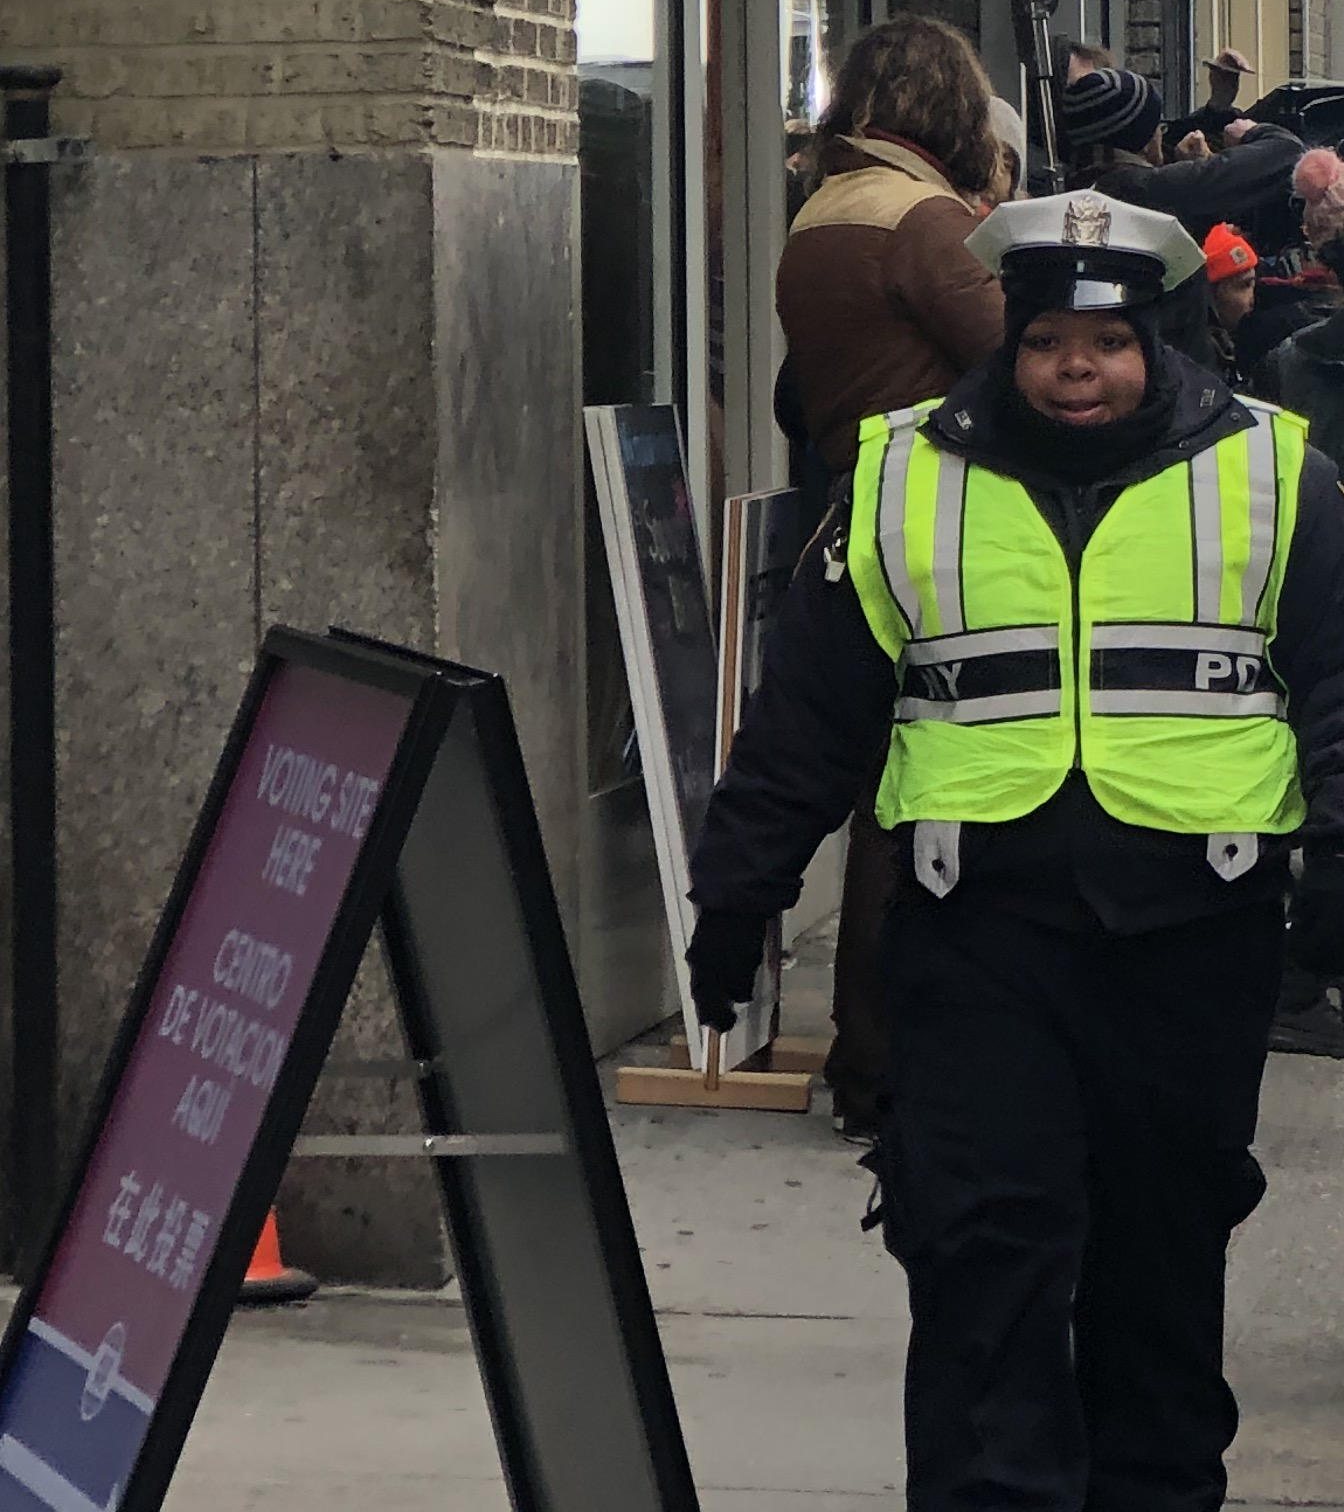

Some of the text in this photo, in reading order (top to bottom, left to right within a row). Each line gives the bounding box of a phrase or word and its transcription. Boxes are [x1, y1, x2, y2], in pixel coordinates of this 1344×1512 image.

[1195, 652, 1261, 693] PD
[257, 743, 378, 839] VOTING SITE
[262, 824, 323, 899] HERE
[213, 928, 293, 1009] CENTRO
[158, 984, 199, 1046] DE
